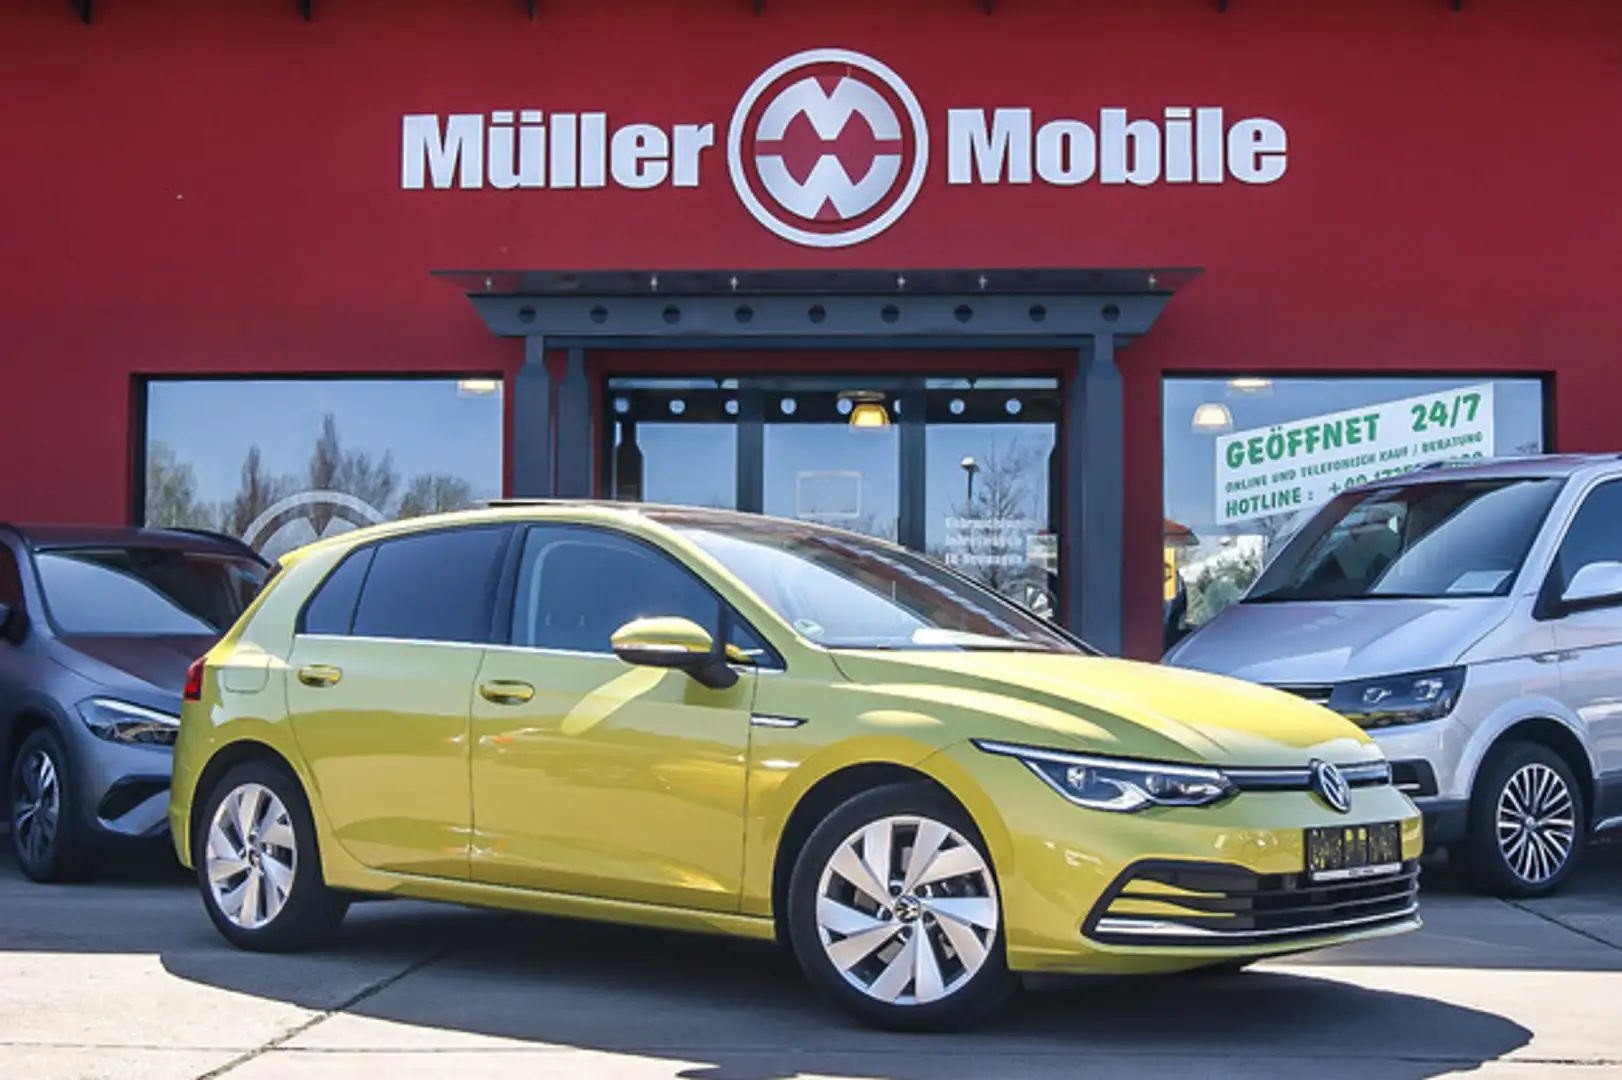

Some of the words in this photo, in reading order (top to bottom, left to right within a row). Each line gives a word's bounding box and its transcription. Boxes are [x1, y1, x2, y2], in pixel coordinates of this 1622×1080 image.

[402, 110, 715, 189] Müller
[947, 106, 1287, 186] Mobile
[1225, 474, 1267, 492] ONLINE
[1271, 469, 1297, 483] UND
[1300, 453, 1376, 477] TELEFONISCH
[1379, 444, 1408, 462] KAUF
[1421, 431, 1484, 452] BERATUNG
[1226, 413, 1380, 469] GEÖFFNET
[1411, 393, 1482, 432] 24/7
[1226, 487, 1301, 517] HOTLINE
